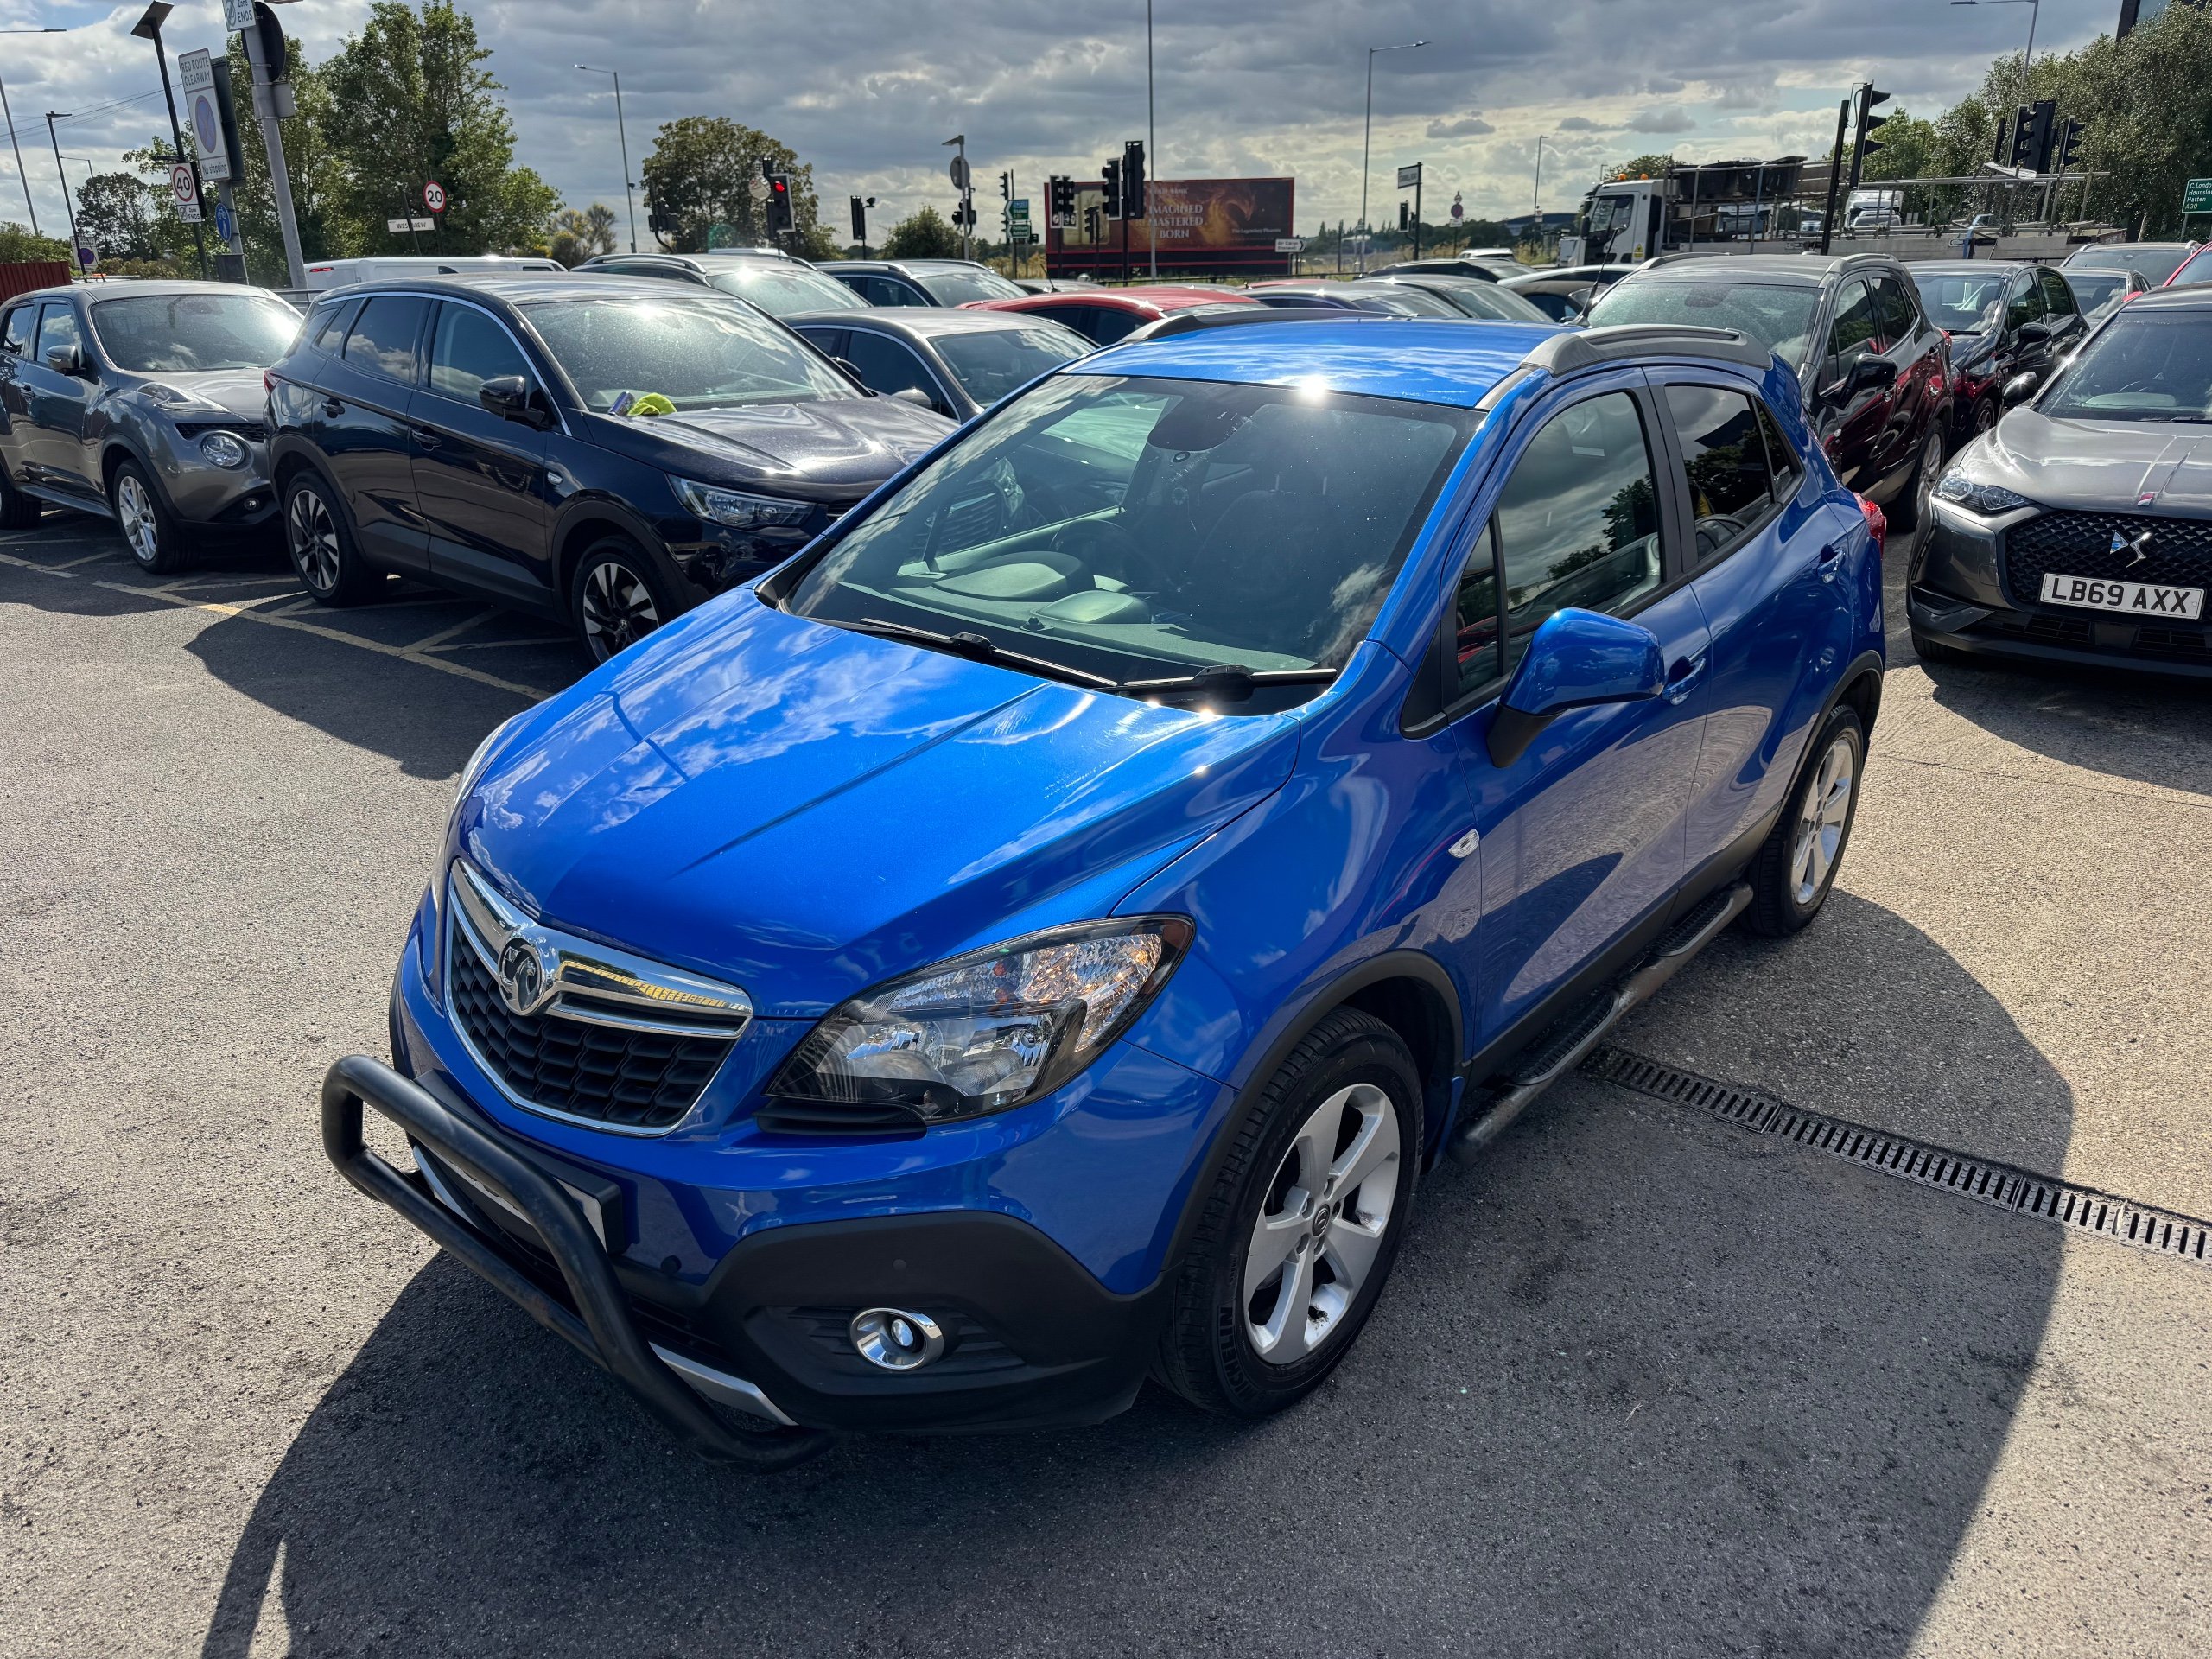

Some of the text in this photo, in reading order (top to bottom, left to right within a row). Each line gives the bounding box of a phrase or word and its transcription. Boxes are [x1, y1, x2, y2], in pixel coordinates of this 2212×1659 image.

[237, 10, 254, 23] ENDS
[181, 56, 210, 71] RED ROUTE
[184, 70, 212, 86] CLEARWAY
[176, 176, 191, 191] 40
[427, 190, 442, 203] 20
[1149, 204, 1204, 214] IMAGINED
[1160, 229, 1190, 238] BORN
[2051, 577, 2190, 613] LB69 AXX
